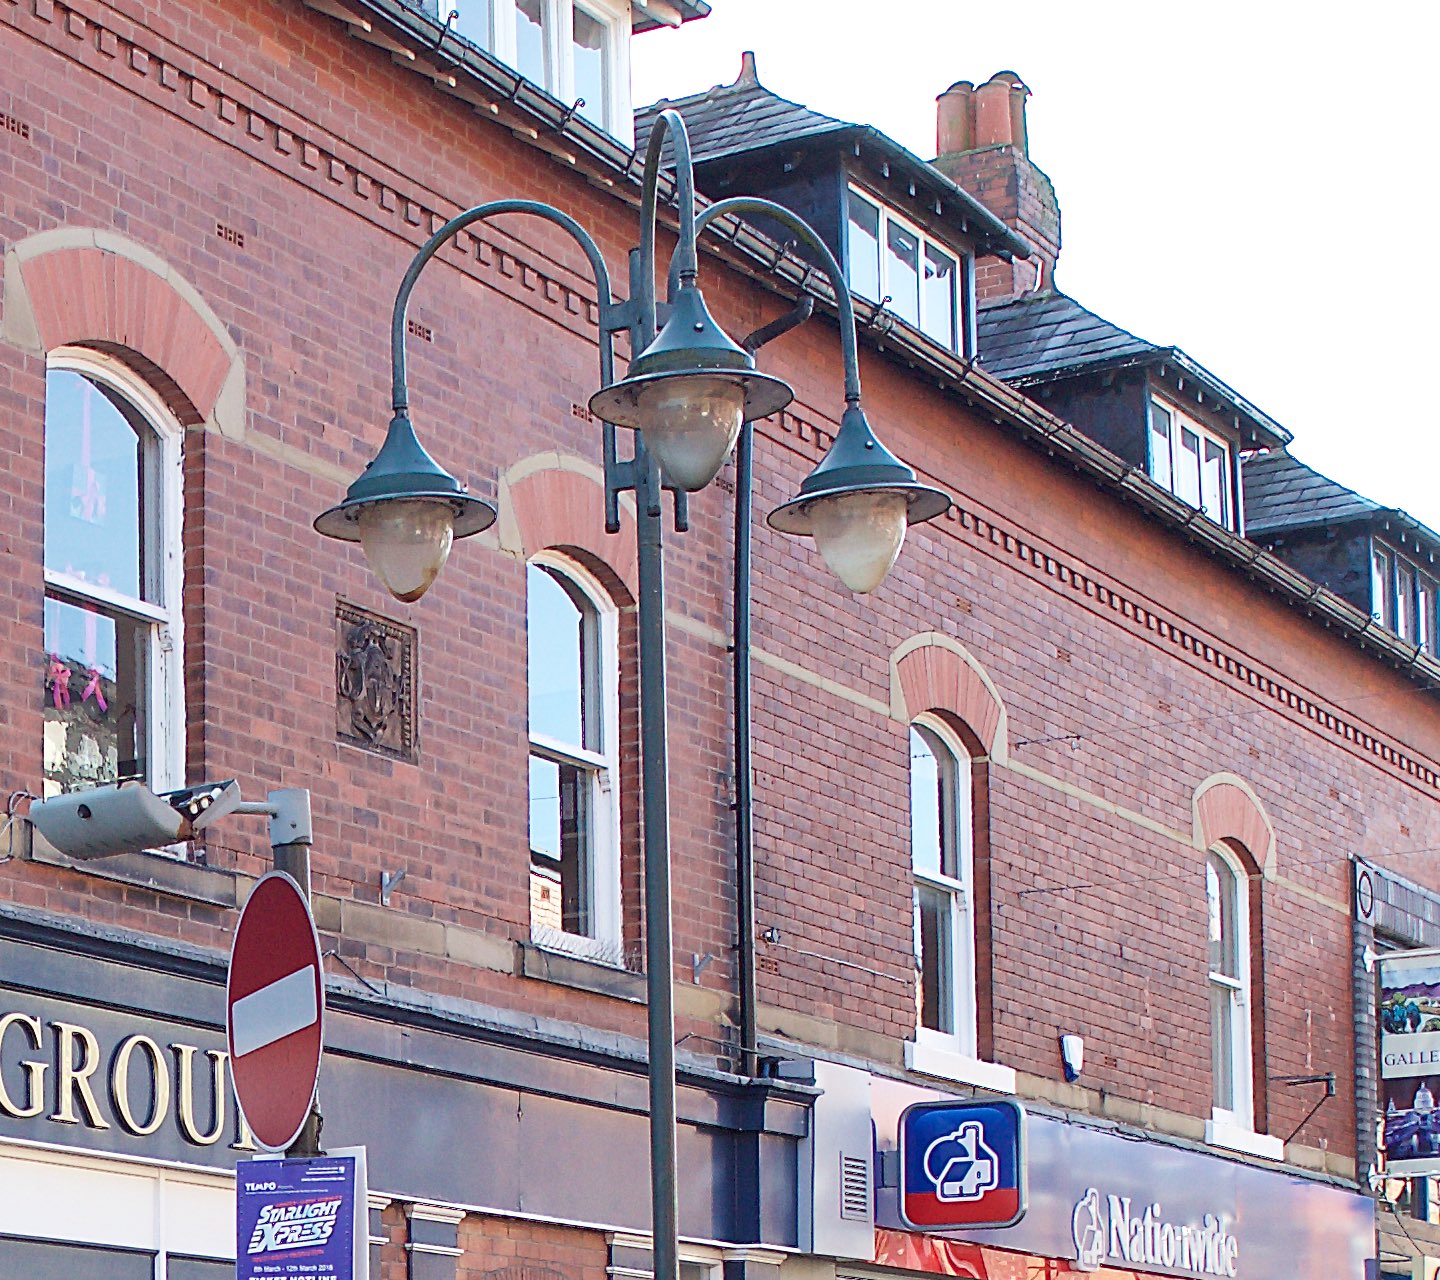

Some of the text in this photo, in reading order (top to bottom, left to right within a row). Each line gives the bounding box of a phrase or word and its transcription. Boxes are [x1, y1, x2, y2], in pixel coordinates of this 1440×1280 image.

[244, 1182, 276, 1191] TEMPO
[257, 1200, 342, 1224] STARLIGHT
[1107, 1194, 1239, 1278] Nationwide
